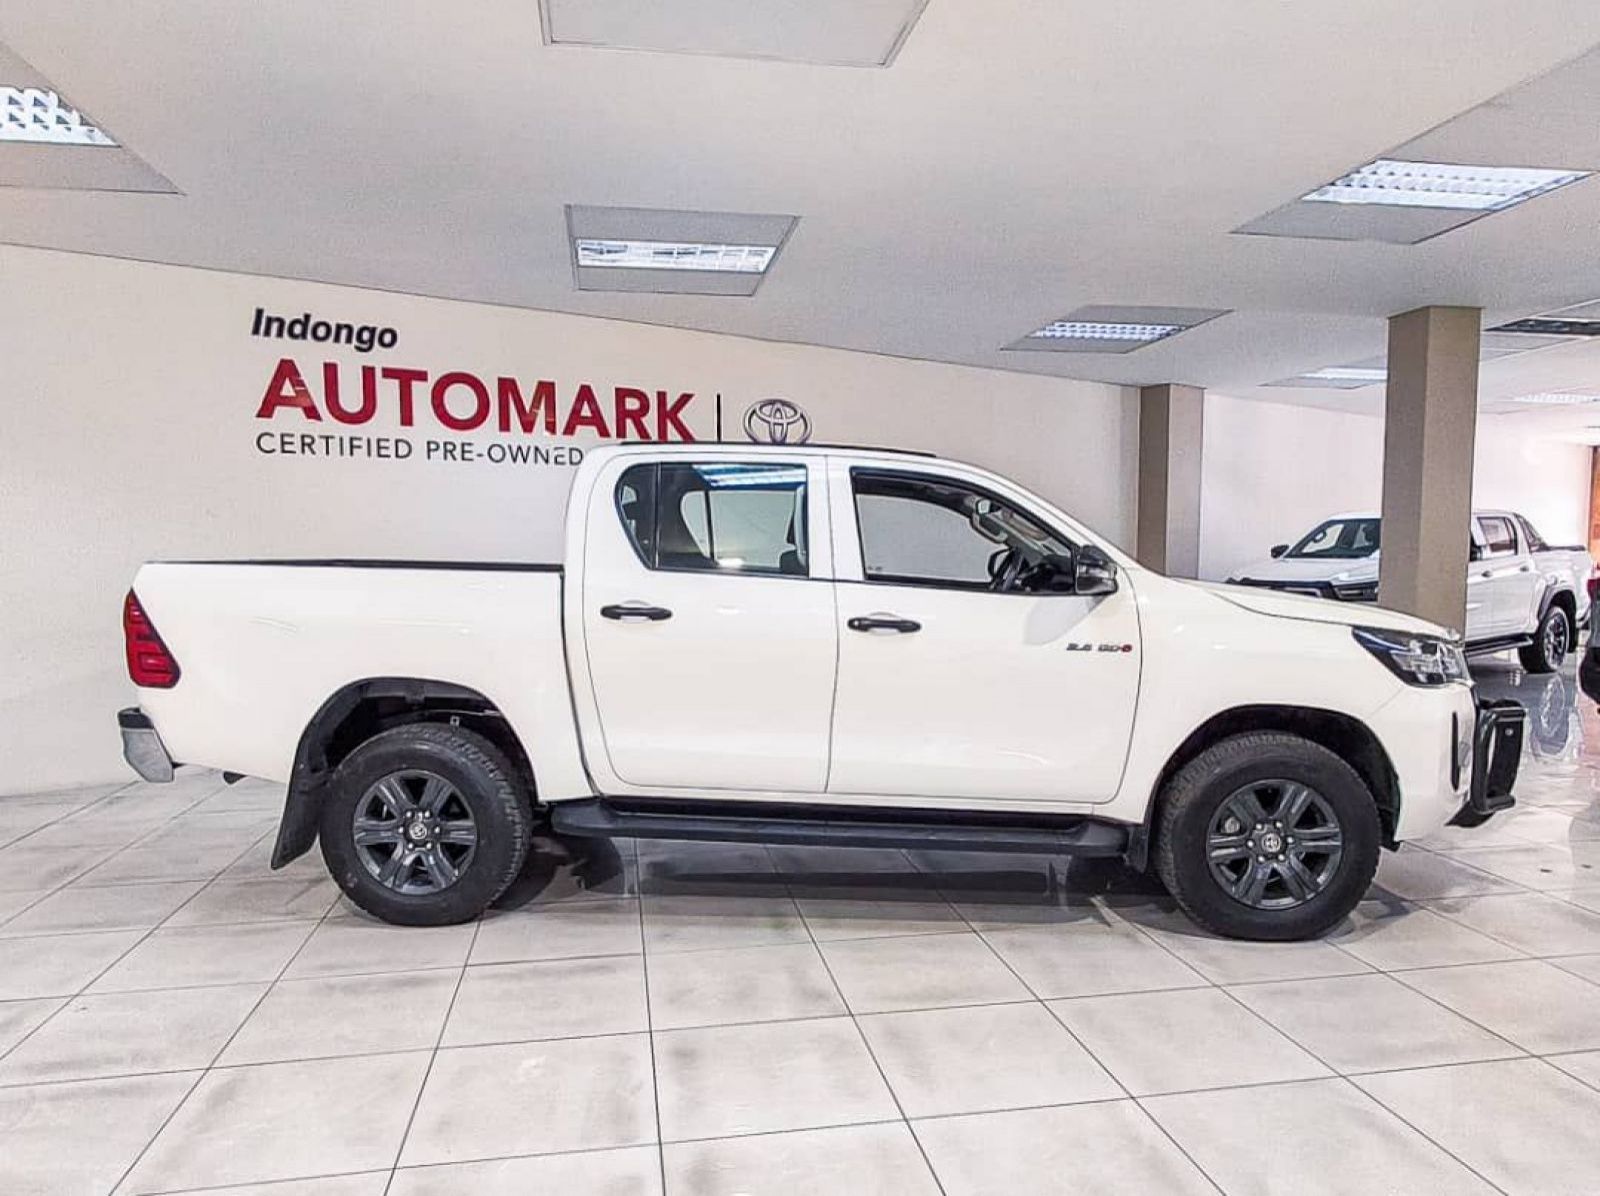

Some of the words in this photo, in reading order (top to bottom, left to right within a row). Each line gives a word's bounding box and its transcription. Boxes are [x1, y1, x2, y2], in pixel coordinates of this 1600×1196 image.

[251, 308, 398, 352] Indongo
[256, 358, 696, 442] AUTOMARK
[256, 432, 412, 459] CERTIFIED
[426, 441, 583, 466] PRE-OWNED
